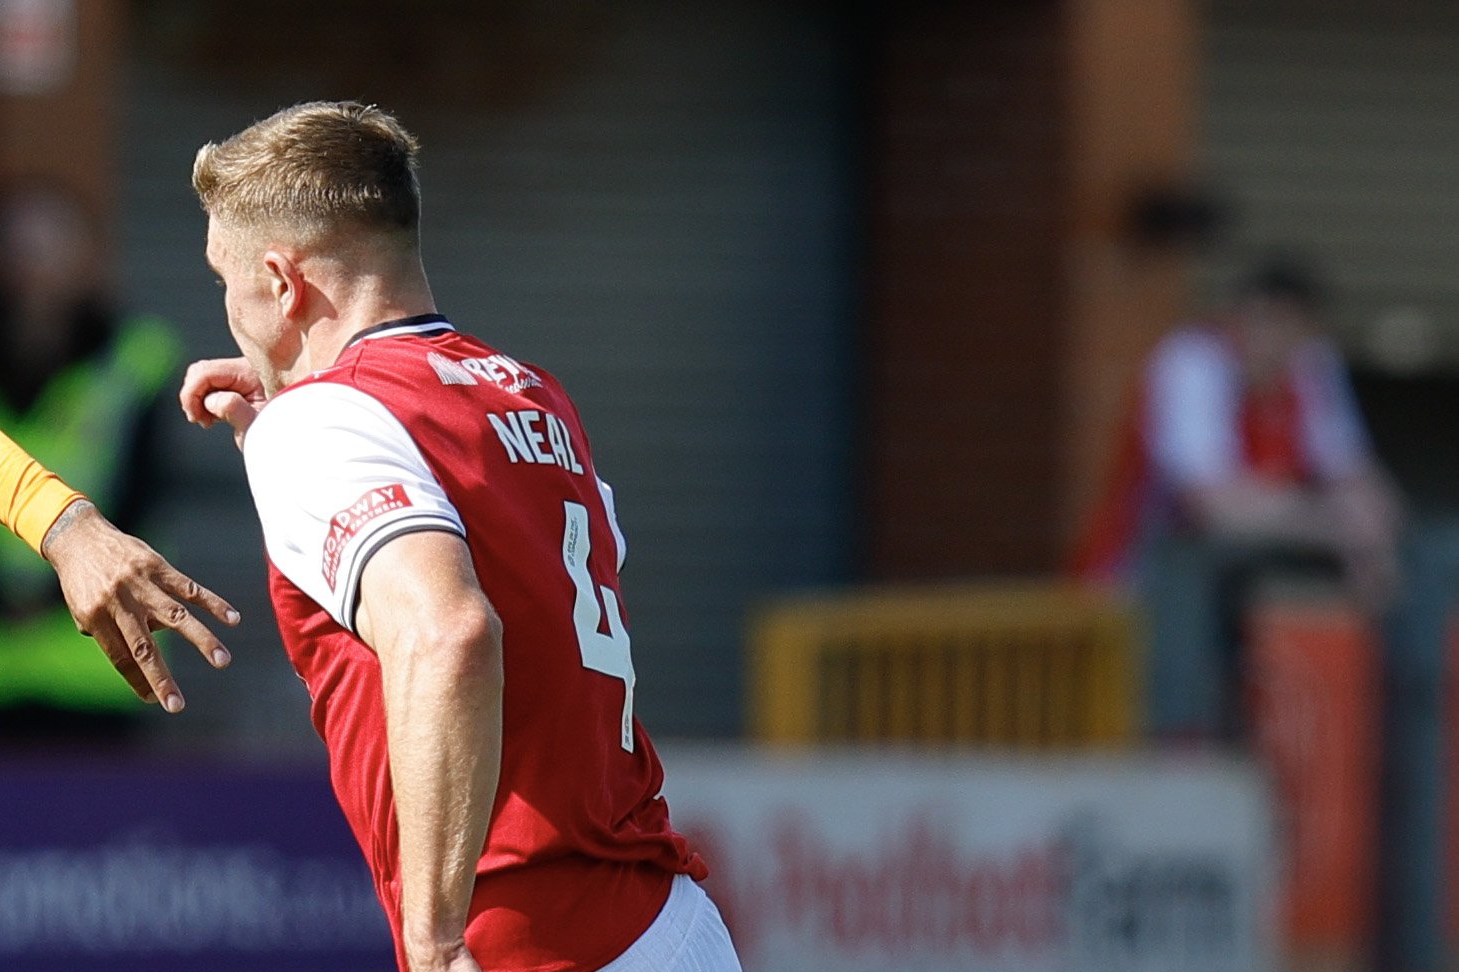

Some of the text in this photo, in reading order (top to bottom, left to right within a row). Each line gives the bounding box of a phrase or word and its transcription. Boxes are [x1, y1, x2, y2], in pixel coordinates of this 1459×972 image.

[487, 409, 584, 475] NEAL
[323, 487, 396, 580] BROADWAY
[562, 501, 636, 753] 4
